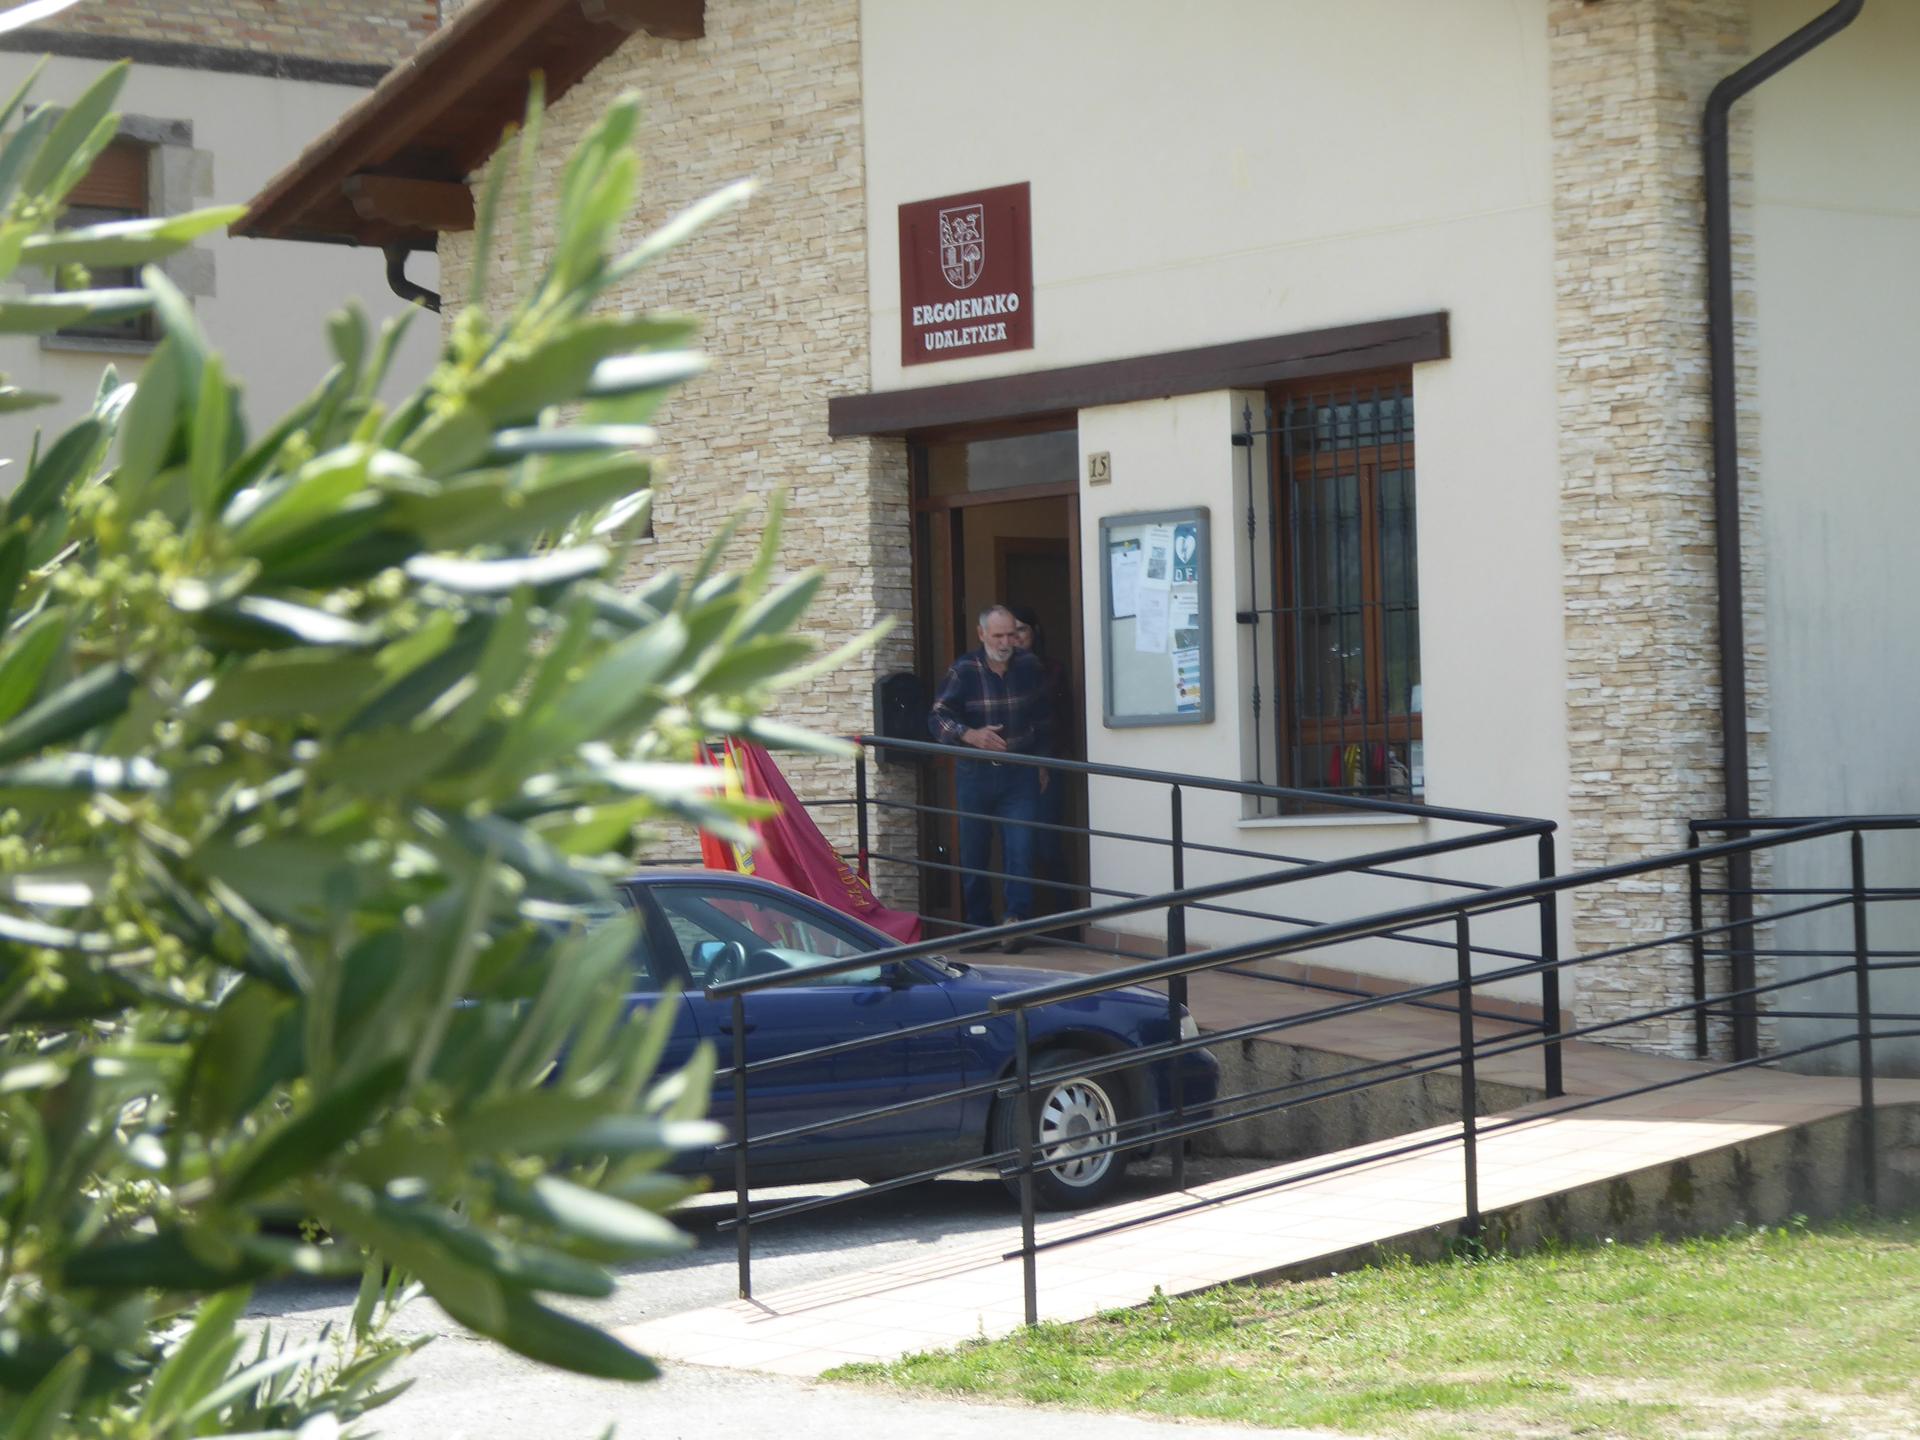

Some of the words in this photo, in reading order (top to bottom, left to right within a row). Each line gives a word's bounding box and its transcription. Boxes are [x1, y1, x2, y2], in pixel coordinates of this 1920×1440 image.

[912, 292, 1020, 326] ERGOIENAKO
[924, 321, 1008, 351] UDALETXEA
[1090, 455, 1107, 478] 15
